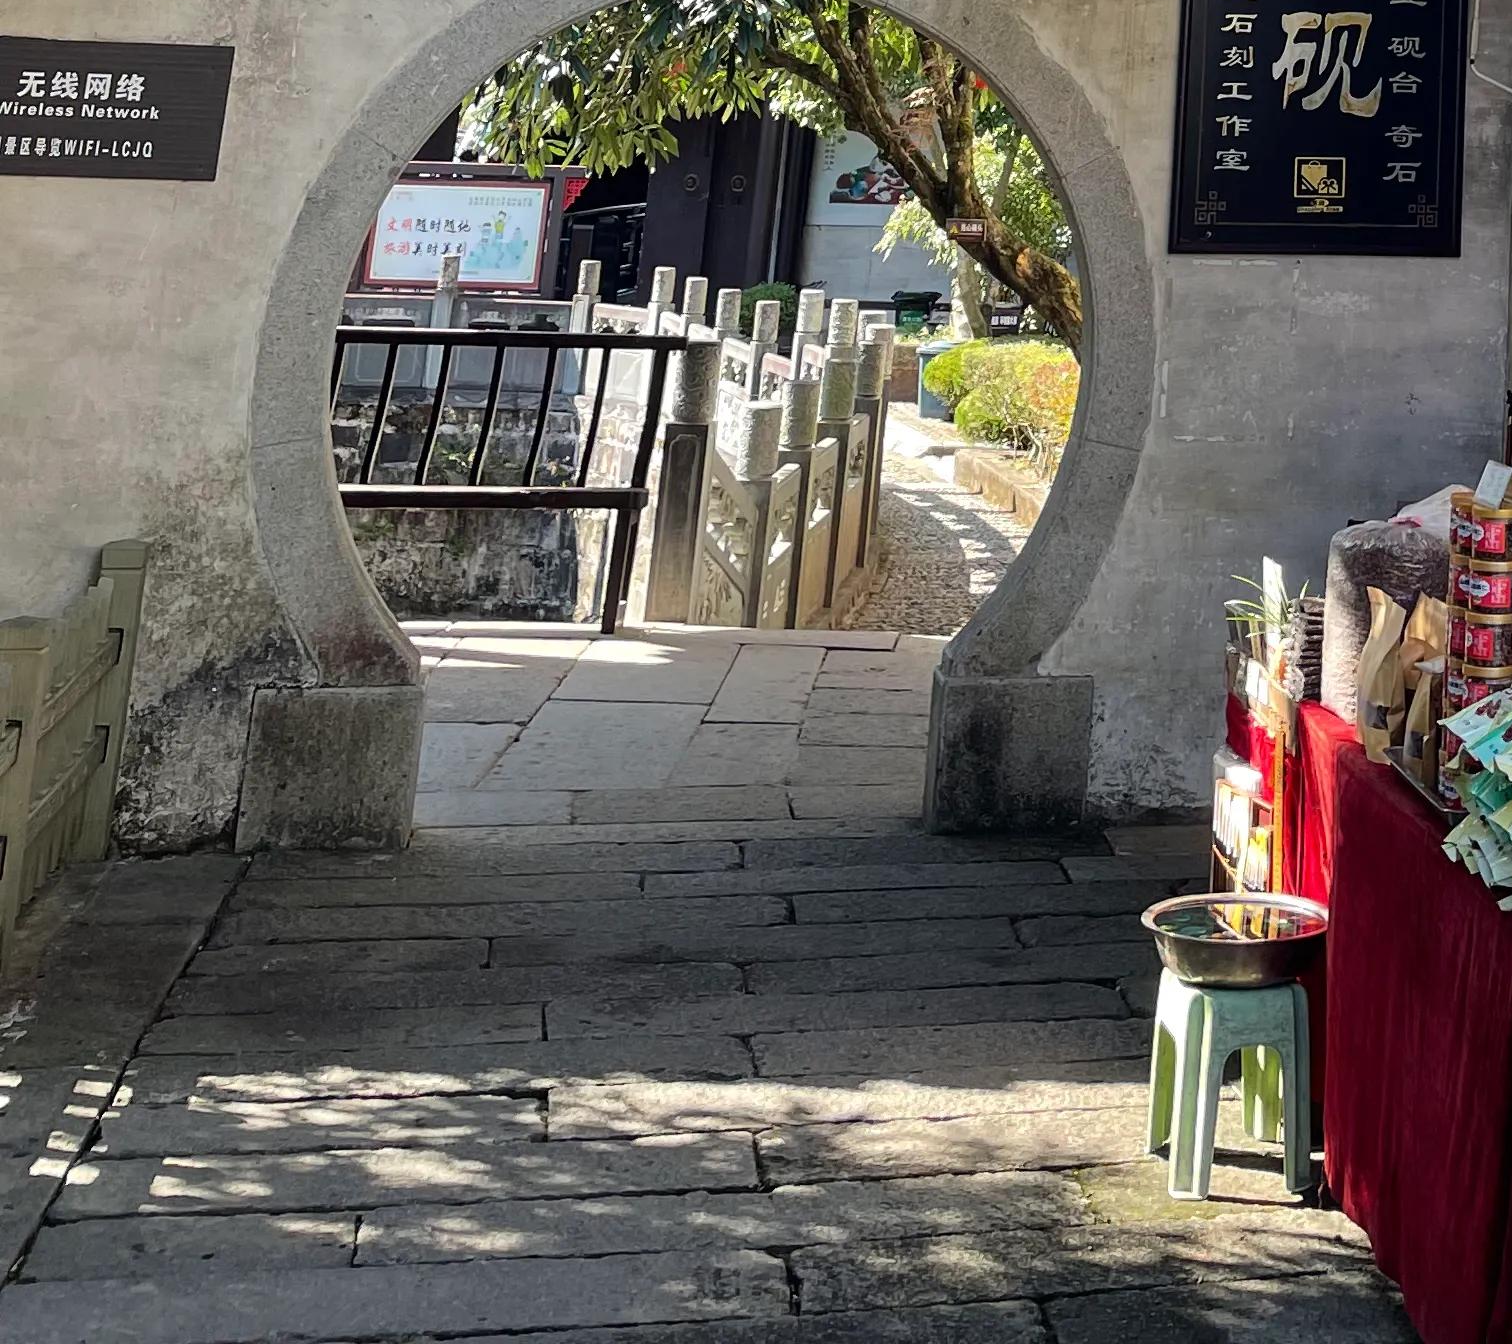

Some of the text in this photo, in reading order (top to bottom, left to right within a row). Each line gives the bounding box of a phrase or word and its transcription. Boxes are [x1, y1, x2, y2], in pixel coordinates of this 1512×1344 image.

[17, 71, 145, 102] 无线网络
[1271, 11, 1383, 118] 砚
[1387, 36, 1427, 94] 砚台
[0, 101, 160, 120] Wireless Network
[0, 135, 153, 158] 景区导览WIFI-LCJQ
[1382, 125, 1423, 184] 奇石
